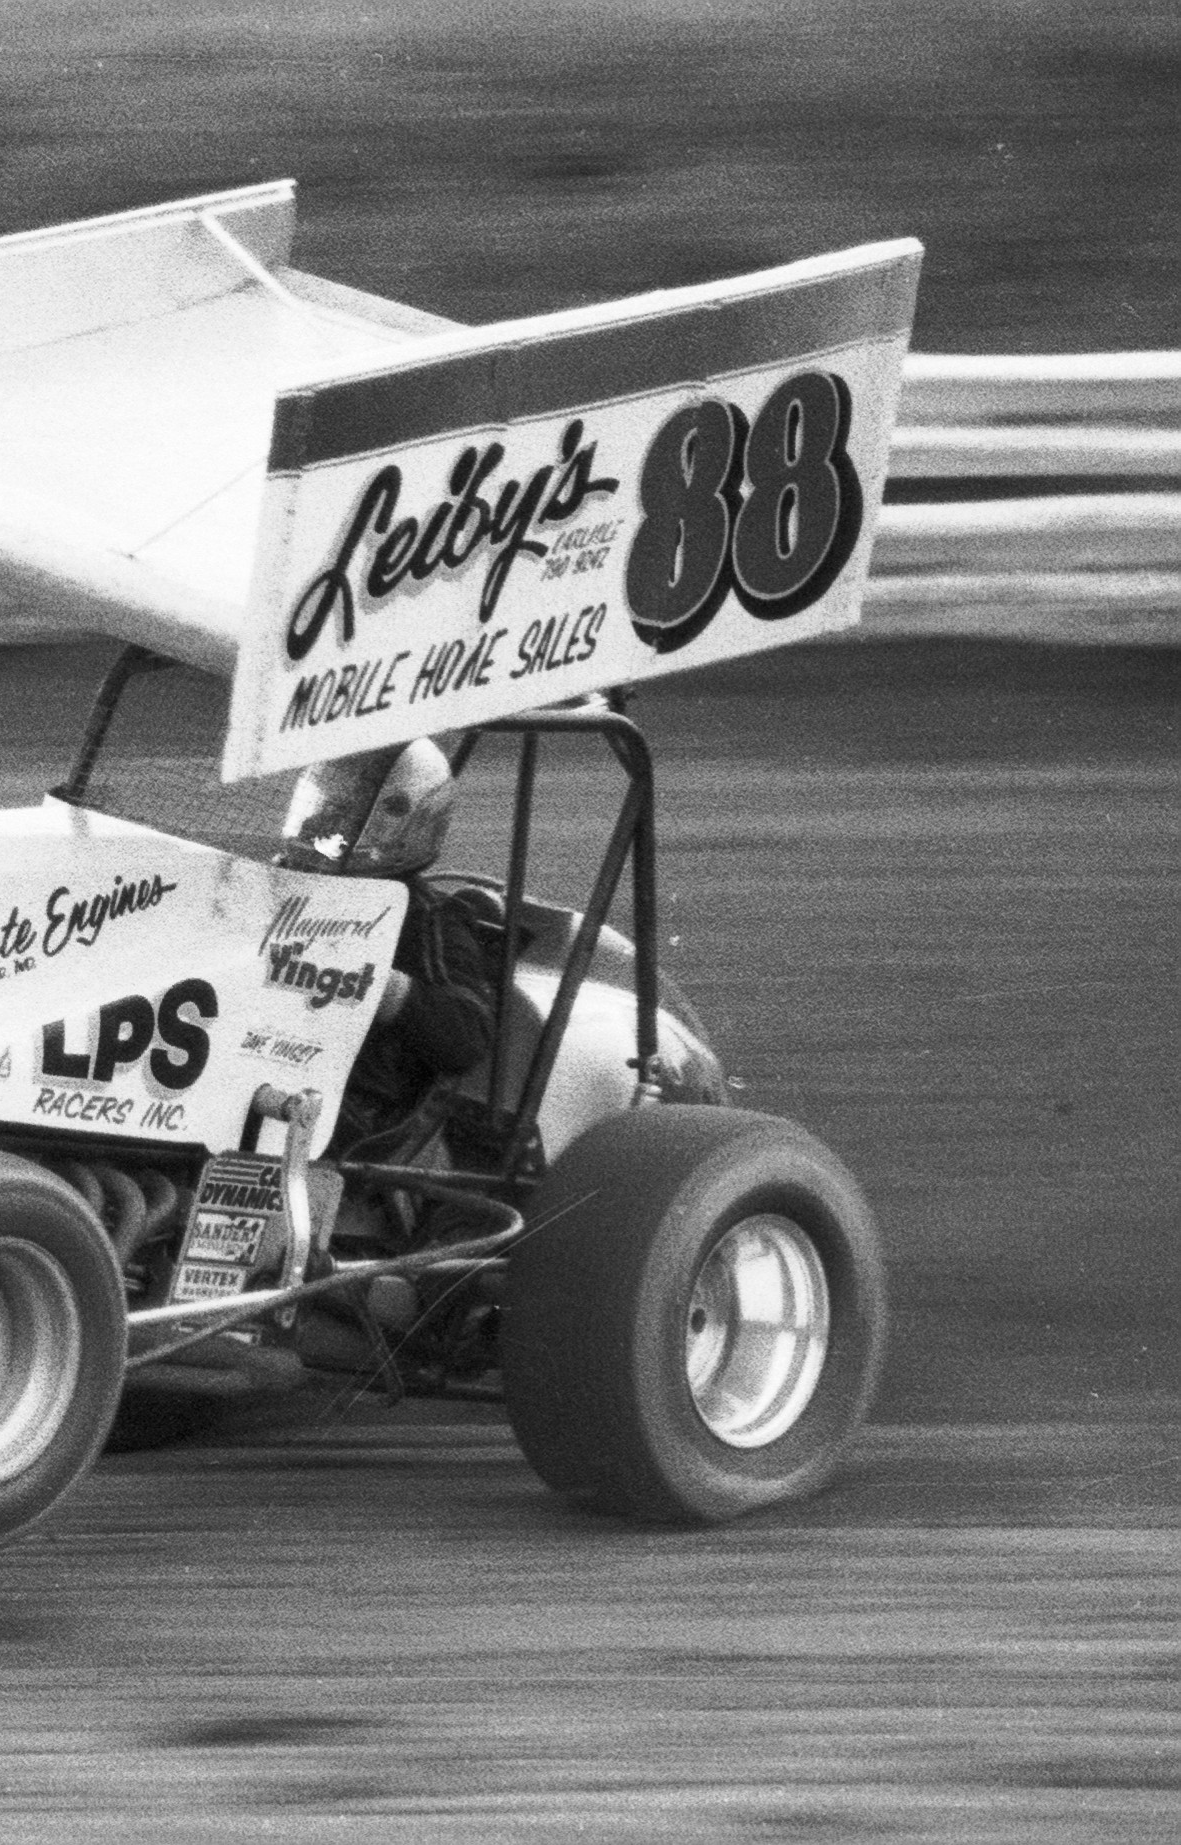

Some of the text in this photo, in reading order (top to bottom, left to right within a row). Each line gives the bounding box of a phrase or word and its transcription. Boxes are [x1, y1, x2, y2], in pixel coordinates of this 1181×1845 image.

[286, 418, 619, 662] Leiby's
[625, 368, 863, 654] 88
[279, 650, 411, 733] MOBILE
[509, 602, 607, 679] SALES
[42, 874, 177, 957] Engines
[269, 941, 375, 1008] Yingst
[40, 977, 219, 1091] LPS
[32, 1087, 188, 1131] RACERS INC.
[259, 1166, 283, 1187] CA
[184, 1268, 240, 1286] VERTEX
